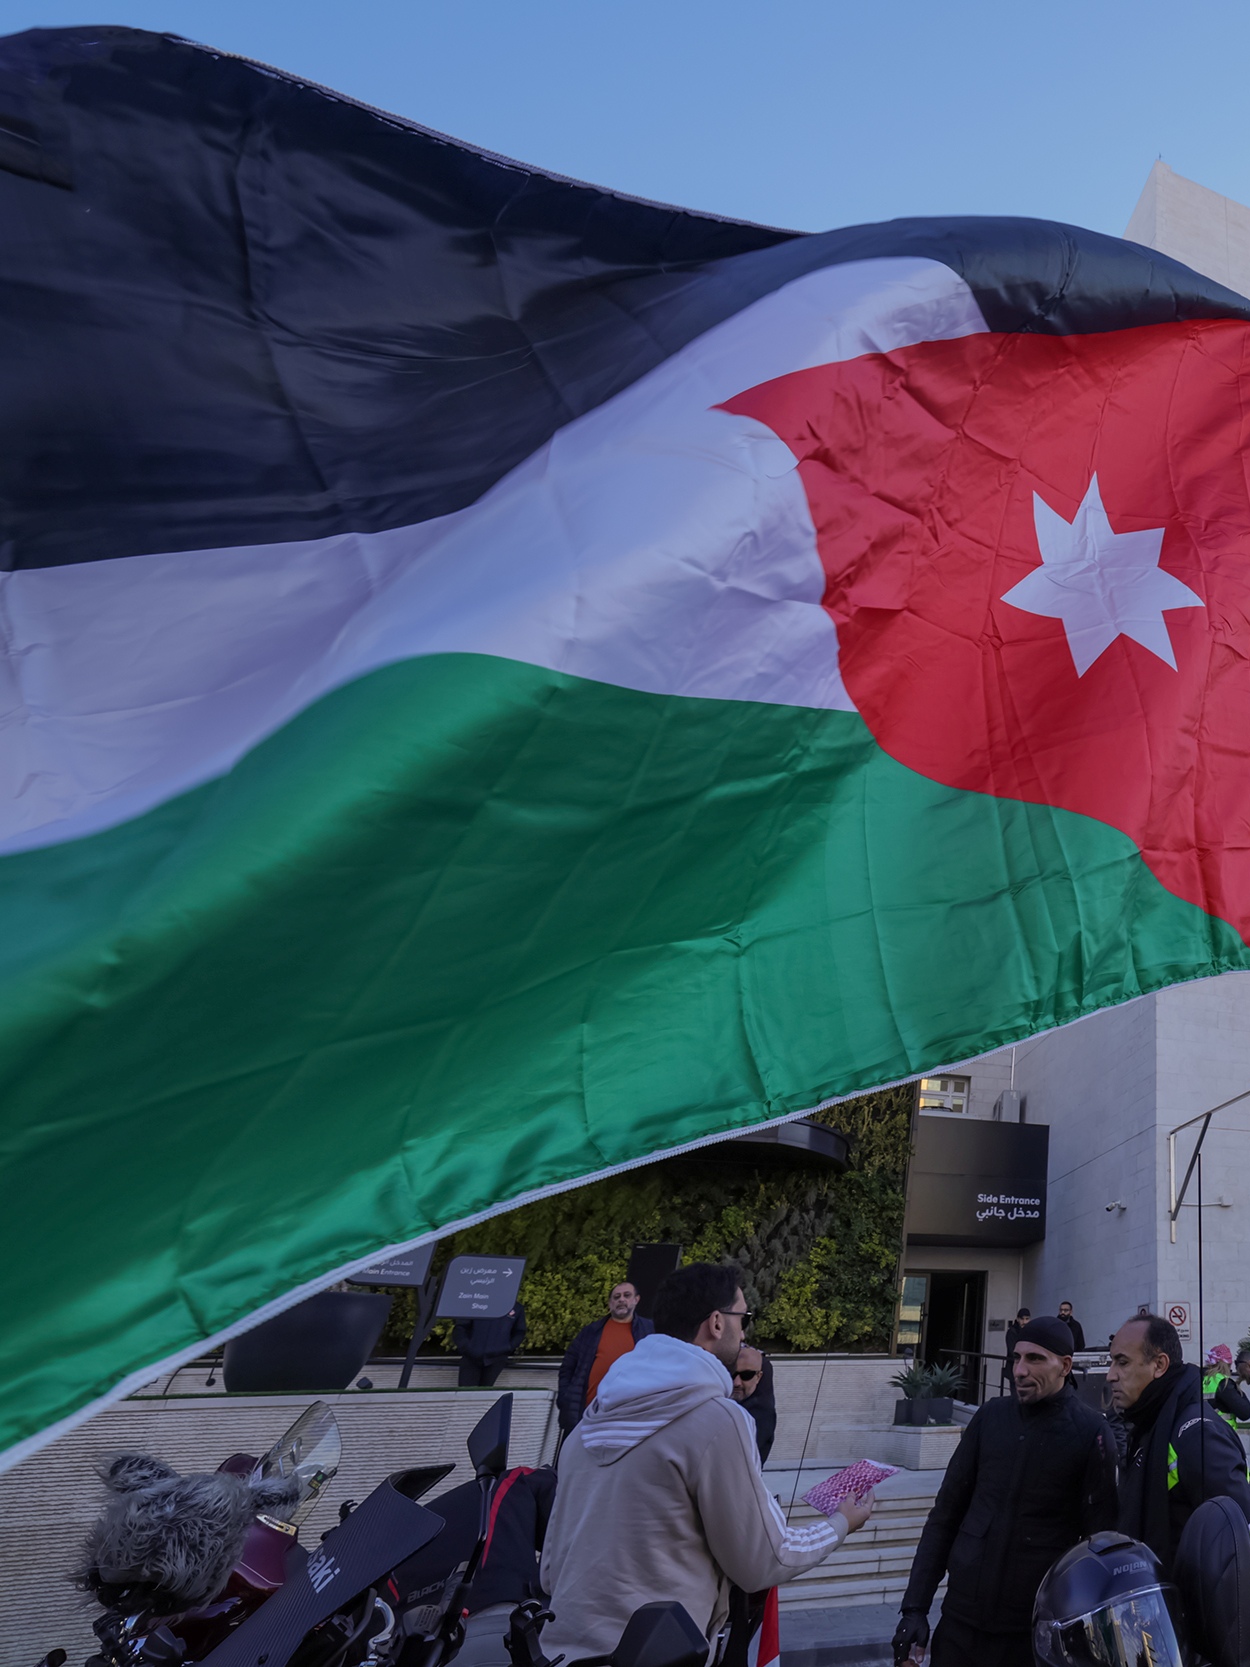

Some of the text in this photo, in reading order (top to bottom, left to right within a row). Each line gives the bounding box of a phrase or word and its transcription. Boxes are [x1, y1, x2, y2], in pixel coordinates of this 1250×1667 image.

[977, 1193, 1040, 1206] Side Entrance
[976, 1206, 1040, 1221] مدخل جانبي
[380, 1268, 411, 1277] Entrance
[471, 1302, 488, 1311] Shop
[1113, 1561, 1148, 1576] NOLAN
